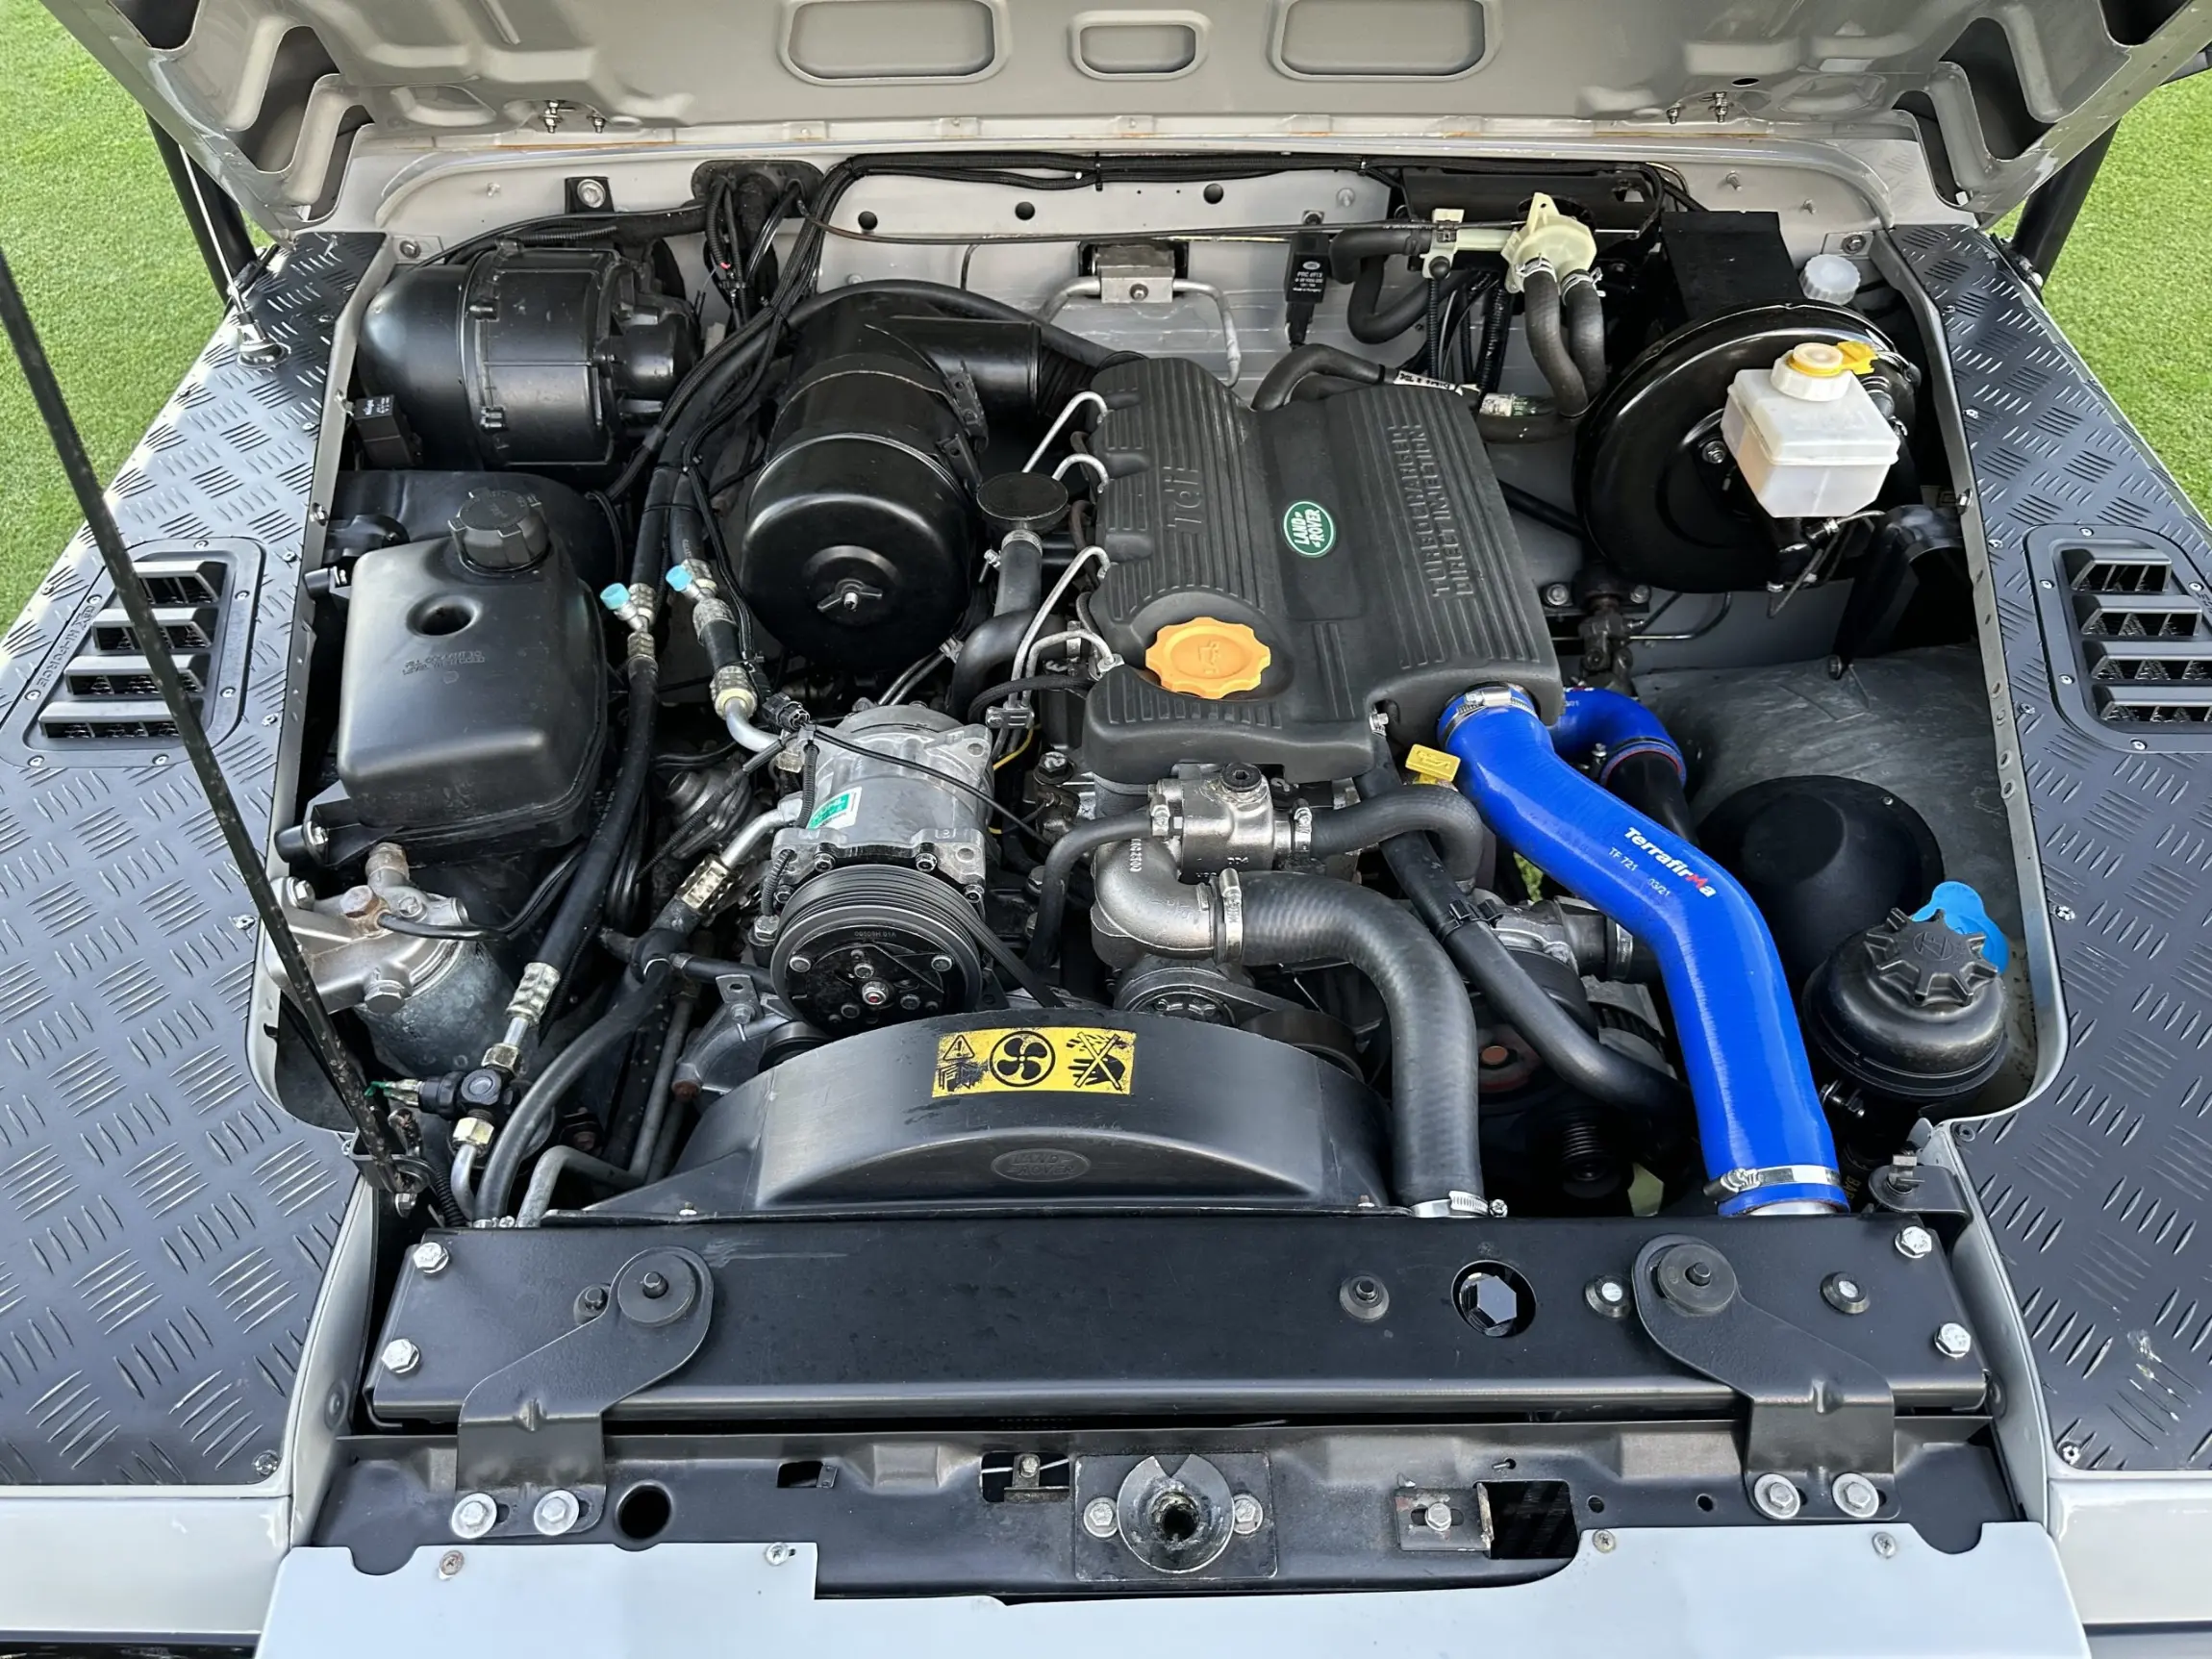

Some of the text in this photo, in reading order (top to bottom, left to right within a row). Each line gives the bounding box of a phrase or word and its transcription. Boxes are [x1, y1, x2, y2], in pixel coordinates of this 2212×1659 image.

[1304, 509, 1325, 542] ROVER
[1391, 432, 1450, 597] TURBOCHARGED
[1409, 430, 1474, 595] DIRECT INJECTION
[1291, 516, 1310, 545] LAND
[1609, 846, 1623, 859] TF
[1621, 856, 1640, 872] 721
[1011, 1153, 1060, 1165] LAND
[1017, 1165, 1074, 1176] ROVER
